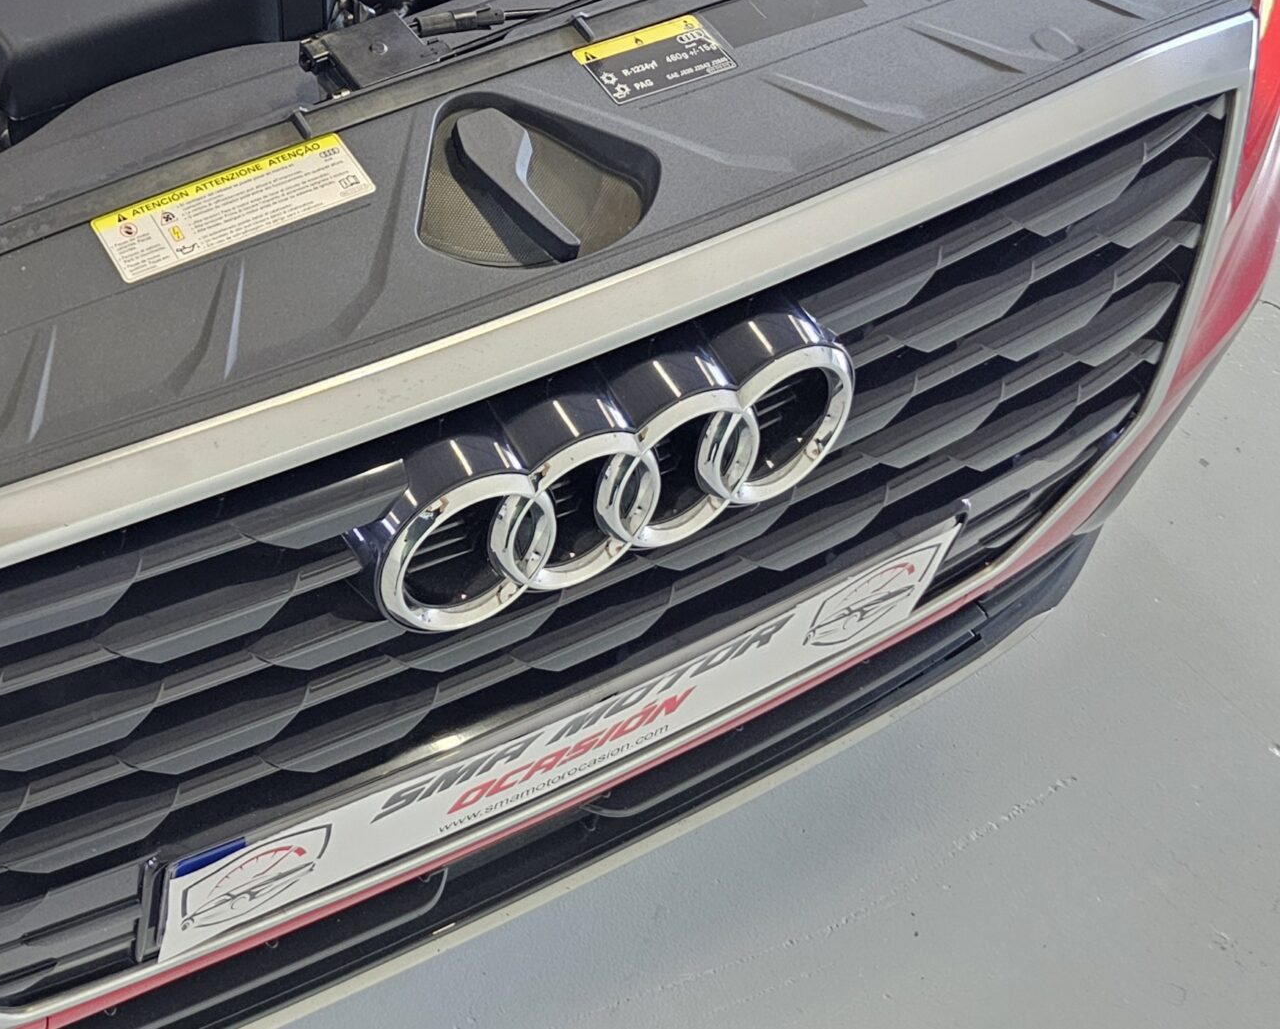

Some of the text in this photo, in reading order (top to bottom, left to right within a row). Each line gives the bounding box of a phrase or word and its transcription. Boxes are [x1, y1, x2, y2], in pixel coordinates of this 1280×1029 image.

[633, 79, 654, 90] PAG
[131, 189, 190, 217] ATENCIÓN
[195, 163, 263, 194] ATTENZIONE
[268, 142, 321, 167] ATENÇÃO
[371, 613, 795, 824] SMA MOTOR
[447, 685, 697, 815] OCASIÓN
[438, 725, 669, 833] www.smamotorocasion.com
